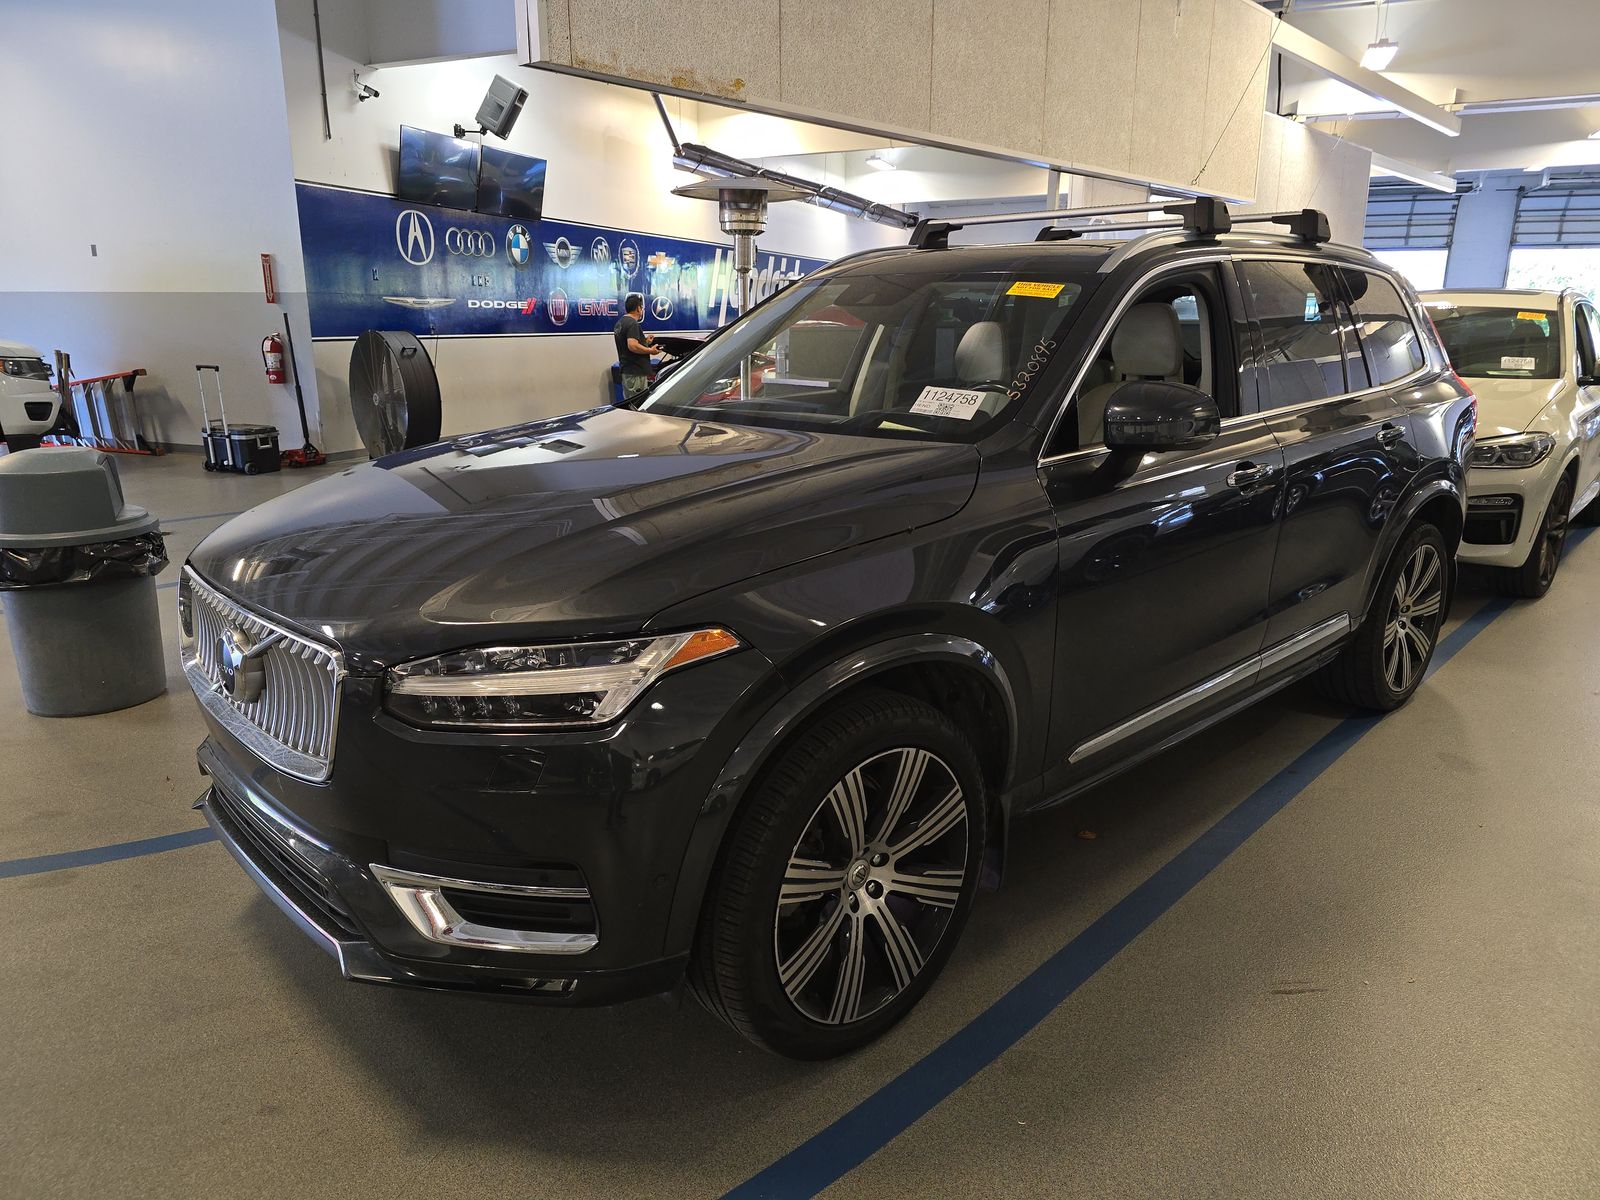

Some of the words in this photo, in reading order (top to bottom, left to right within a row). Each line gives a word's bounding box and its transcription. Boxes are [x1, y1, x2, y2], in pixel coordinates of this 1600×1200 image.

[508, 225, 531, 242] BMW
[468, 300, 528, 309] DODGE
[578, 298, 619, 316] GMC
[1007, 337, 1056, 400] 5320895
[923, 389, 979, 406] 1124758
